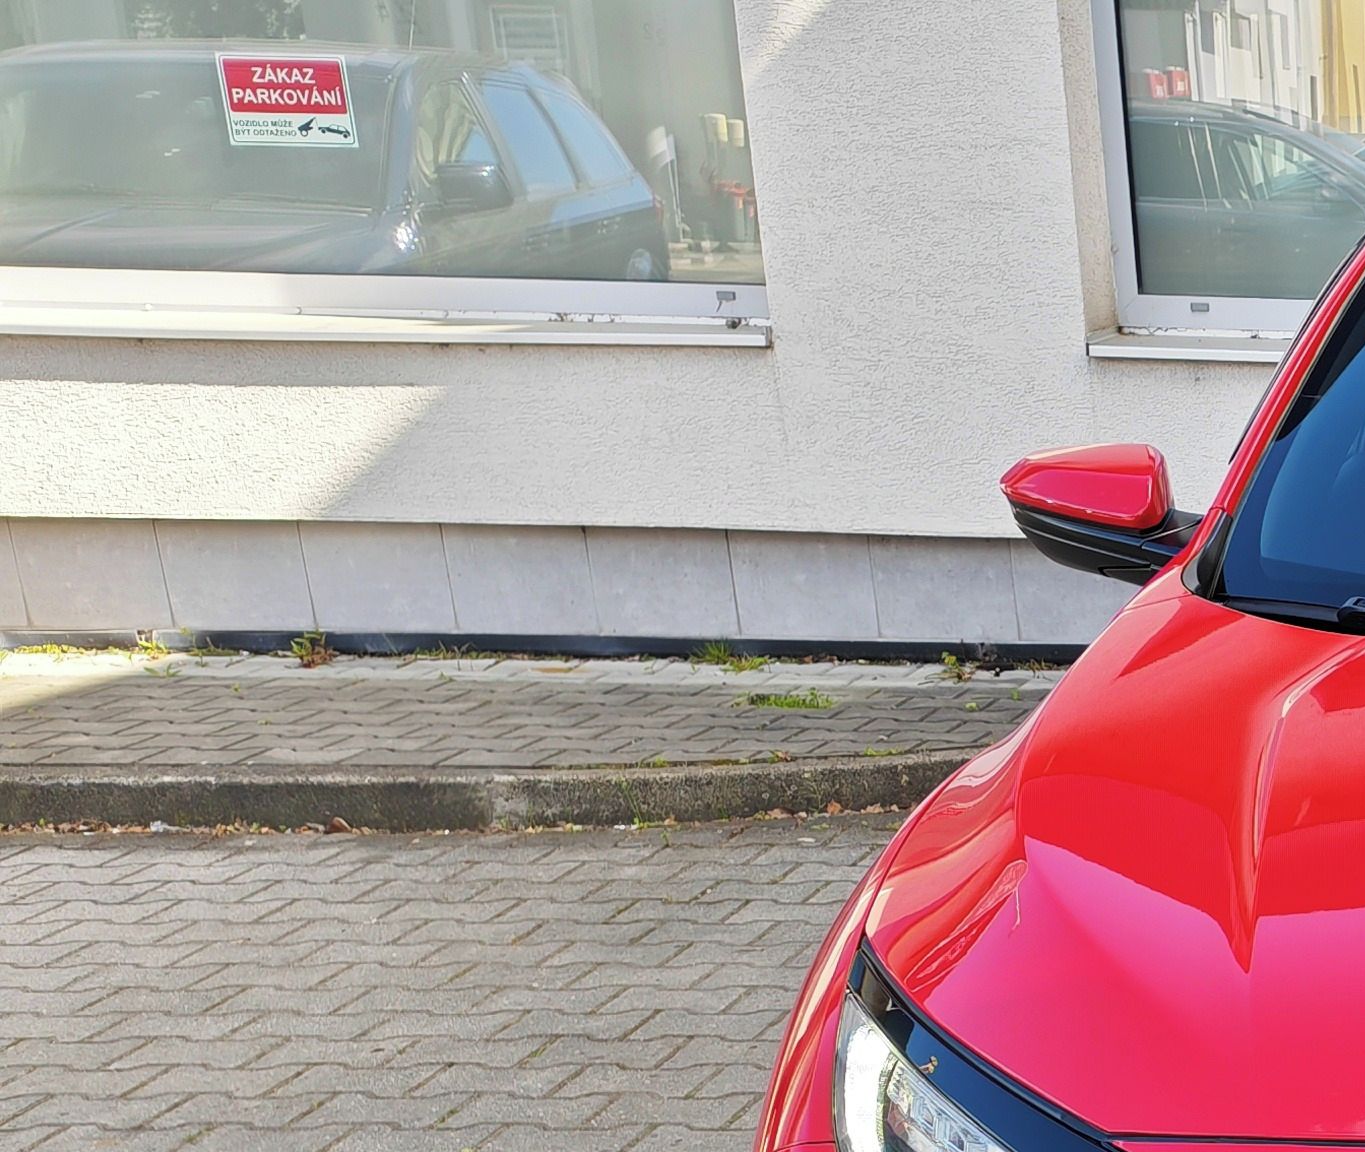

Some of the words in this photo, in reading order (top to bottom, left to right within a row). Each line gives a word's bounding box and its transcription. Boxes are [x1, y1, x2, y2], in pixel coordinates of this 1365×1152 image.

[251, 64, 315, 84] ZÁKAZ
[231, 86, 342, 106] PARKOVÁNÍ
[232, 119, 269, 127] VOZIDLO
[270, 118, 294, 128] MŮŽE
[252, 128, 297, 137] ODTAŽENO
